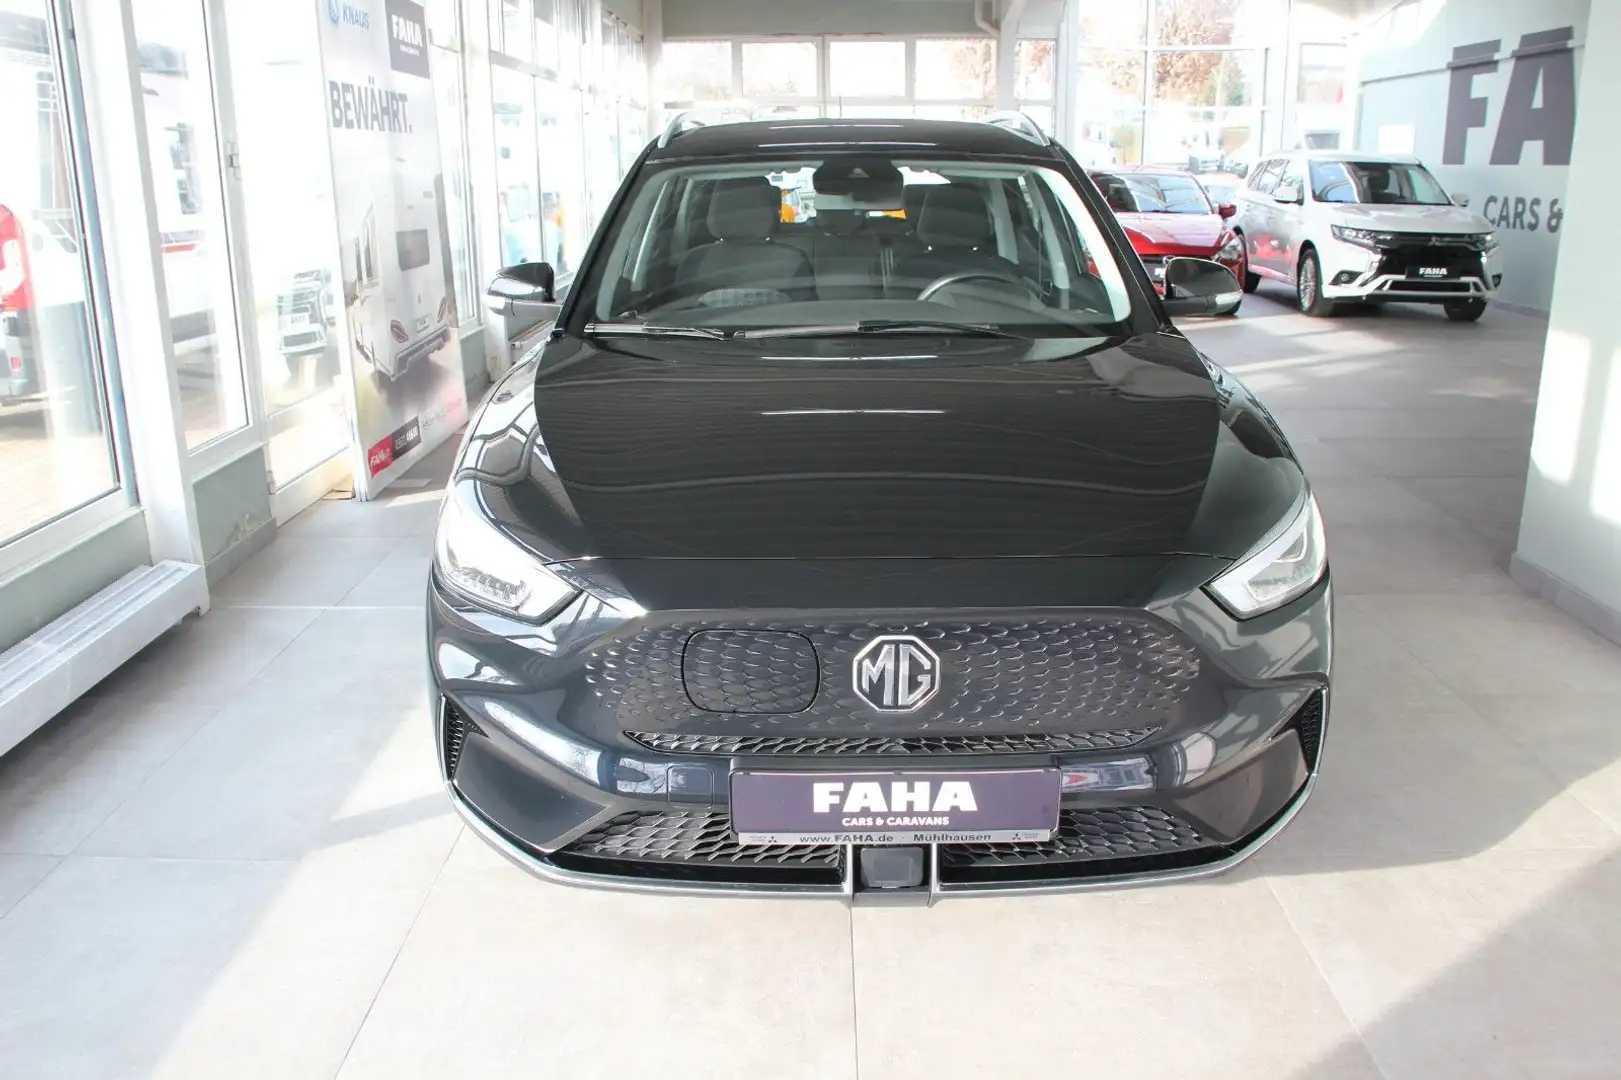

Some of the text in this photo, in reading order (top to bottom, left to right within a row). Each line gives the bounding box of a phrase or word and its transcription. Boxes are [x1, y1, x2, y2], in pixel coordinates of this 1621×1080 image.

[342, 5, 370, 29] KNAUS
[391, 14, 424, 47] FAHA
[328, 76, 413, 134] BEWÄHRT.
[1483, 194, 1541, 232] CARS
[861, 643, 932, 706] MG
[813, 781, 979, 813] FAHA
[842, 815, 950, 827] CARS & CARAVANS
[799, 833, 894, 843] www.FAHA.de
[912, 832, 992, 843] Mühlhausen
